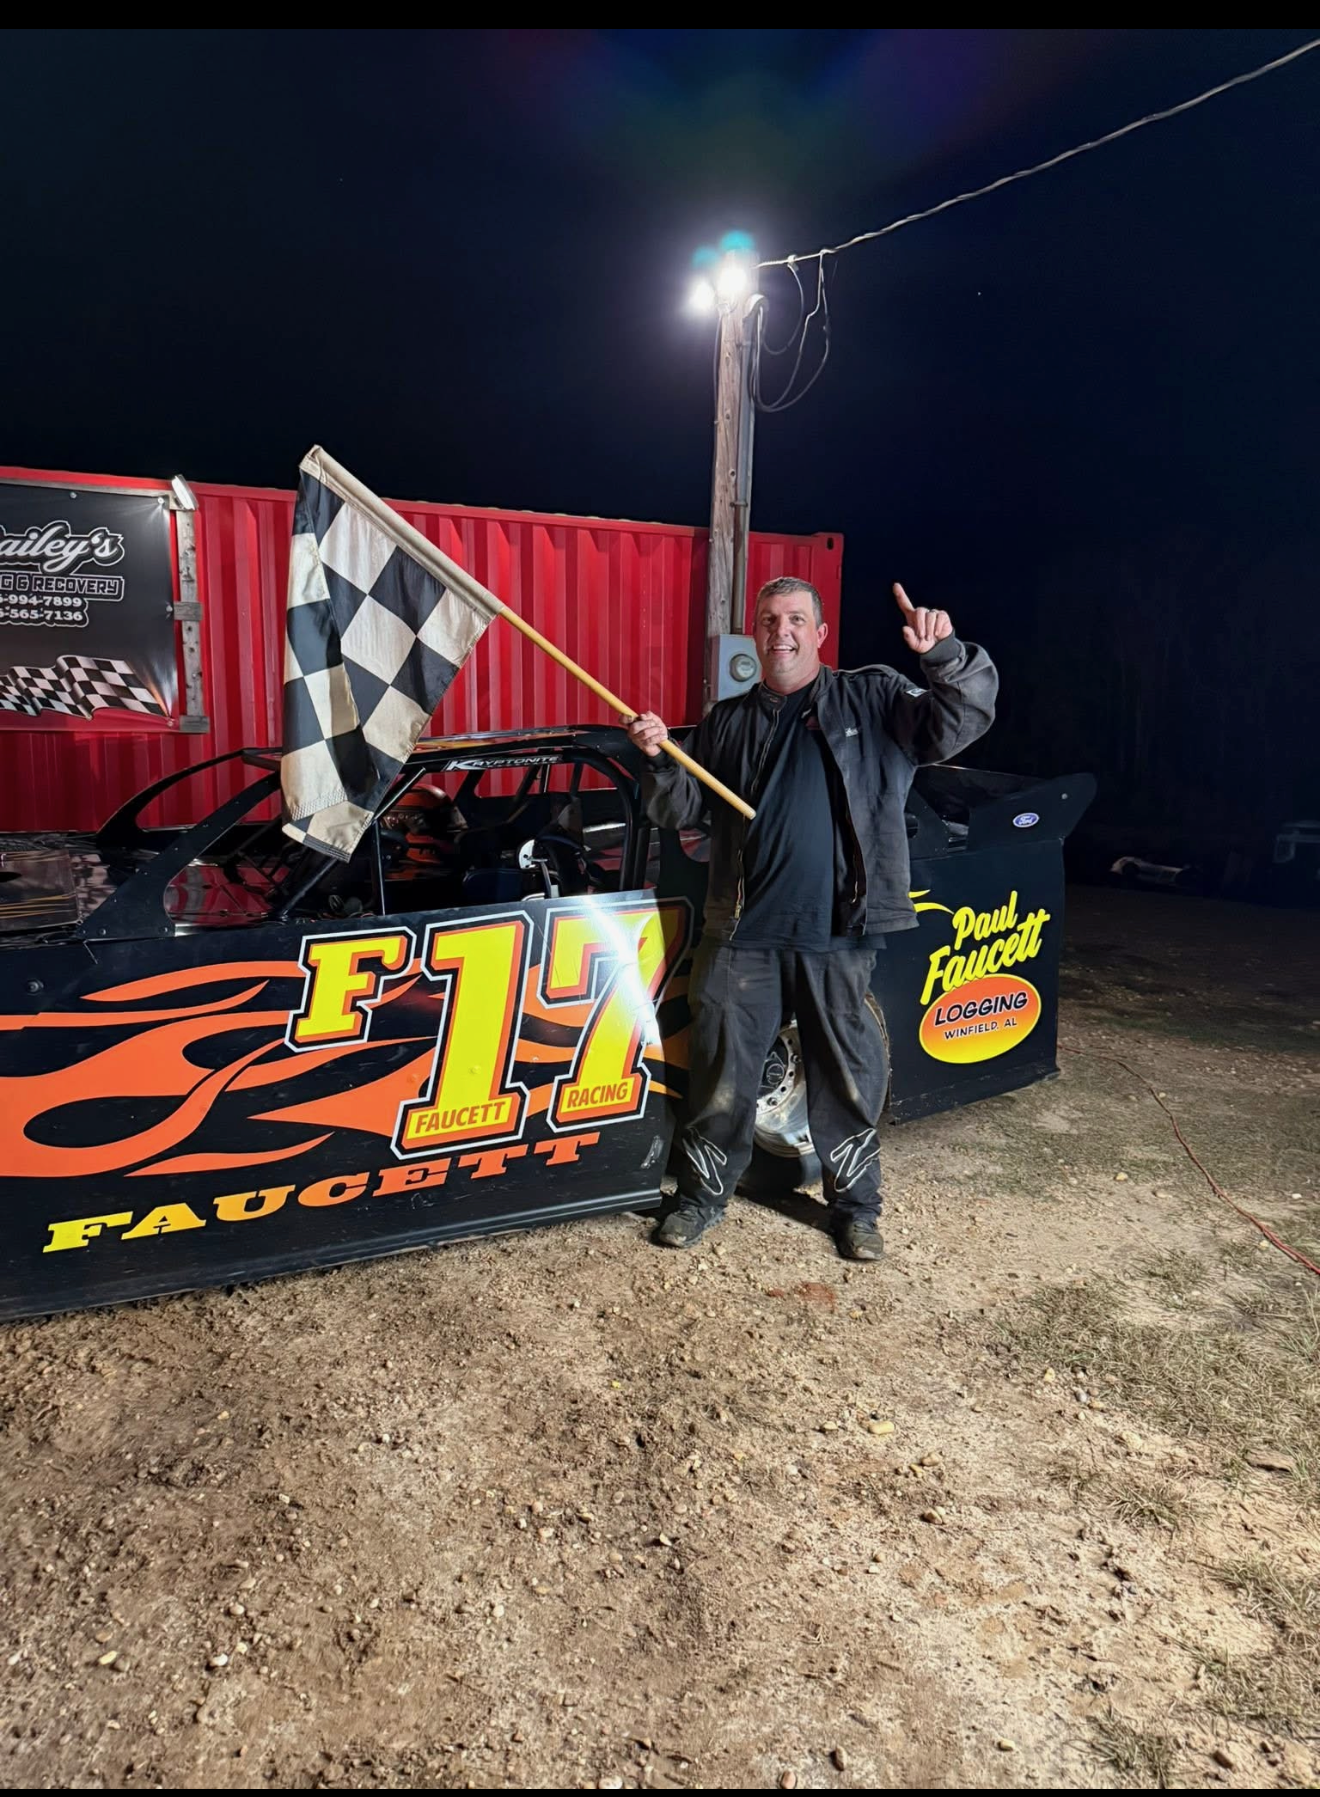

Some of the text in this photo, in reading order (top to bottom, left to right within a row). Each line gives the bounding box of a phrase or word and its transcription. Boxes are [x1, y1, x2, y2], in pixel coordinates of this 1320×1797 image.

[32, 575, 120, 595] RECOVERY
[0, 594, 82, 607] -994-7899
[446, 756, 560, 771] KRYPTONITE
[952, 890, 1018, 951] Paul
[920, 908, 1050, 1005] Faucett
[934, 992, 1028, 1026] LOGGING
[1003, 1016, 1018, 1028] AL
[566, 1081, 629, 1109] RACING
[415, 1101, 507, 1134] FAUCETT
[42, 1131, 600, 1254] FAUCETT
